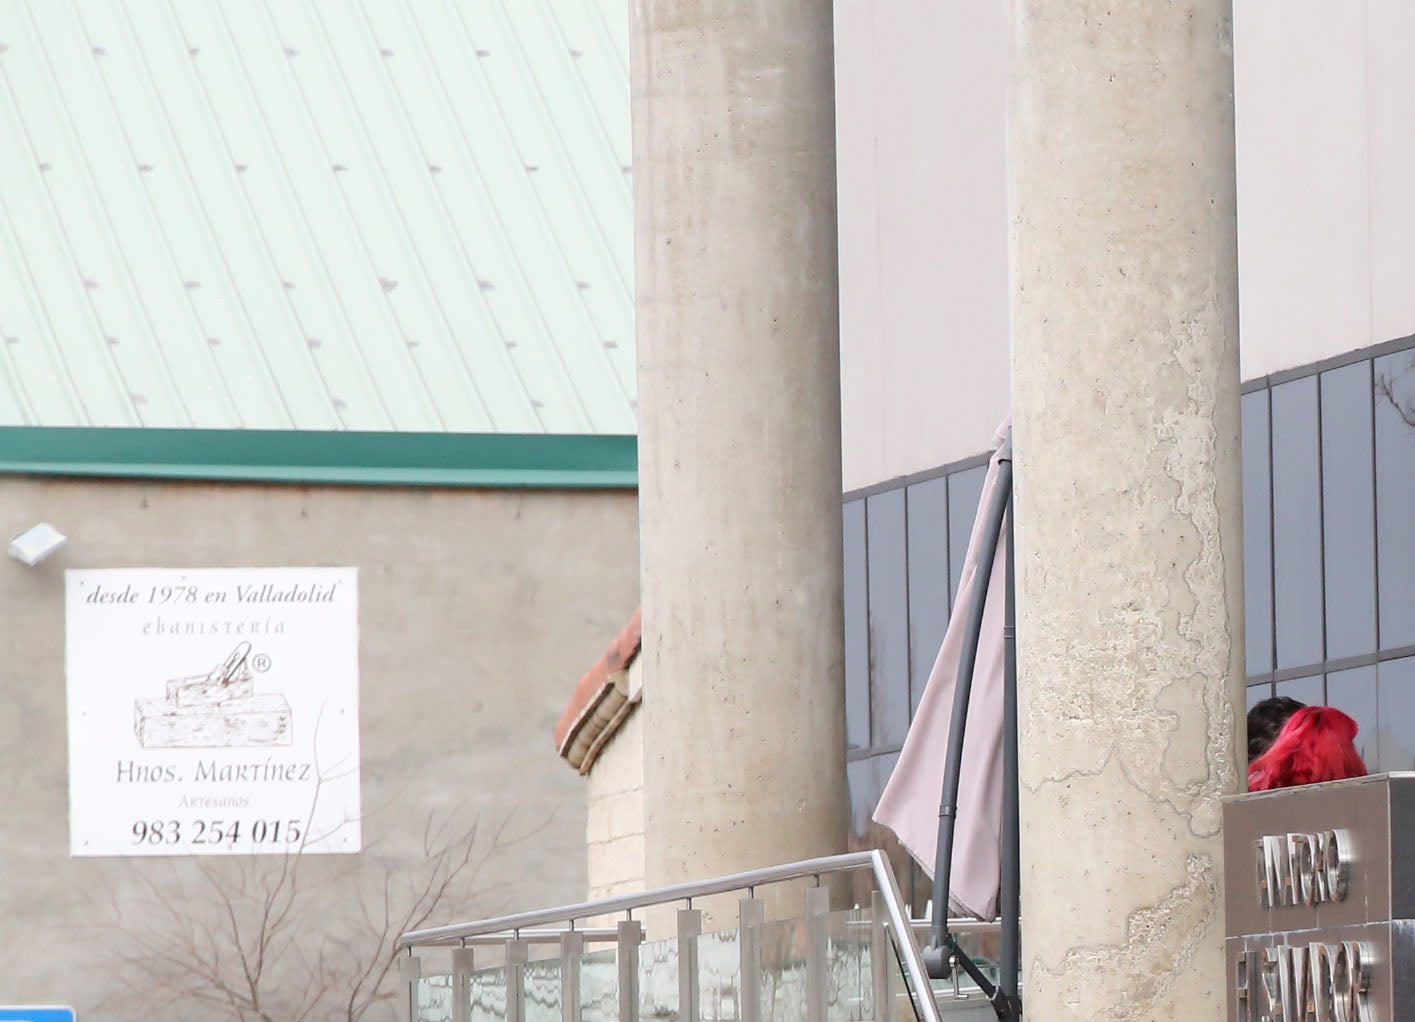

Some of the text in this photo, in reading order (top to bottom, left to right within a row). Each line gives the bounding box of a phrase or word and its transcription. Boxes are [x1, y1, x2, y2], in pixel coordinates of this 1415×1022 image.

[86, 582, 338, 604] desde 1978 en Valladolid
[115, 756, 311, 783] Hnos. Martínez
[131, 819, 301, 846] 983 254 015
